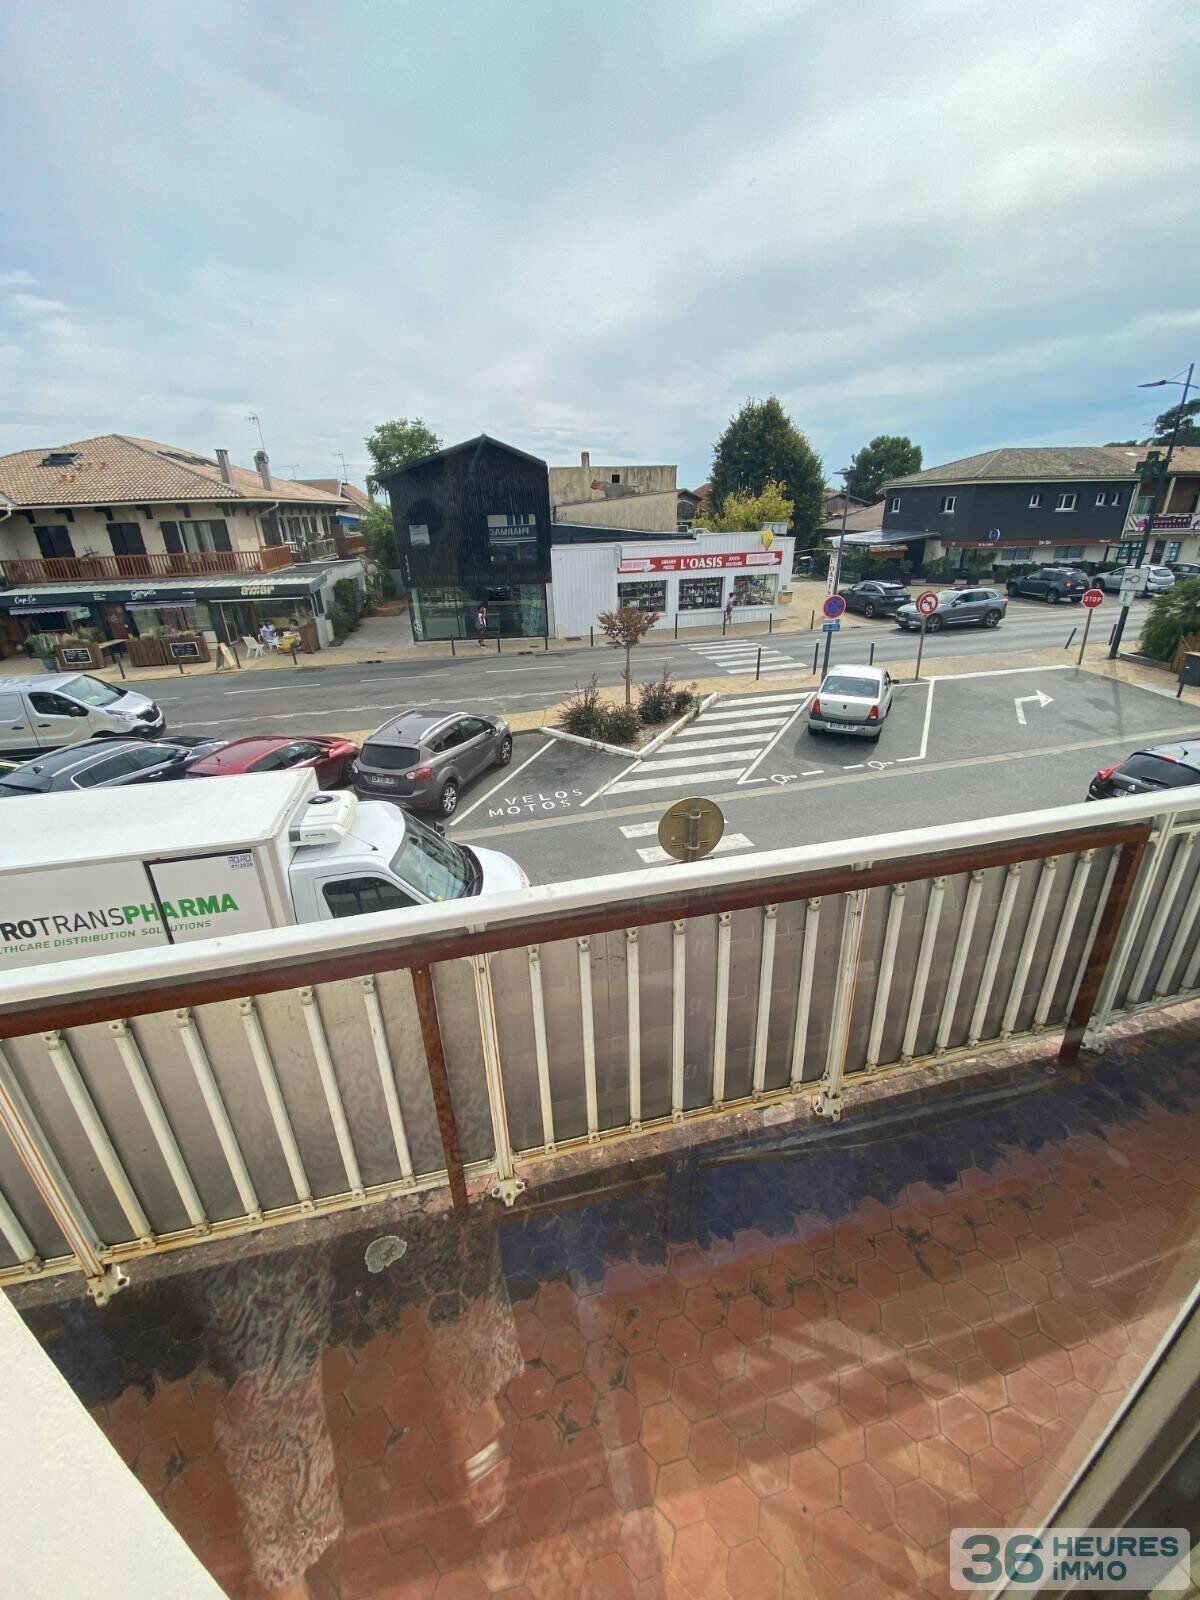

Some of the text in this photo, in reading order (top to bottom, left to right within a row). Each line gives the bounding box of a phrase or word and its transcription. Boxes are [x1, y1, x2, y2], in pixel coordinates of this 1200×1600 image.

[680, 556, 723, 570] L'OASIS
[504, 788, 583, 805] VELOS
[488, 799, 571, 817] MOTOS
[54, 929, 136, 948] DISTRIBUTION
[141, 920, 212, 936] SOLUTIONS
